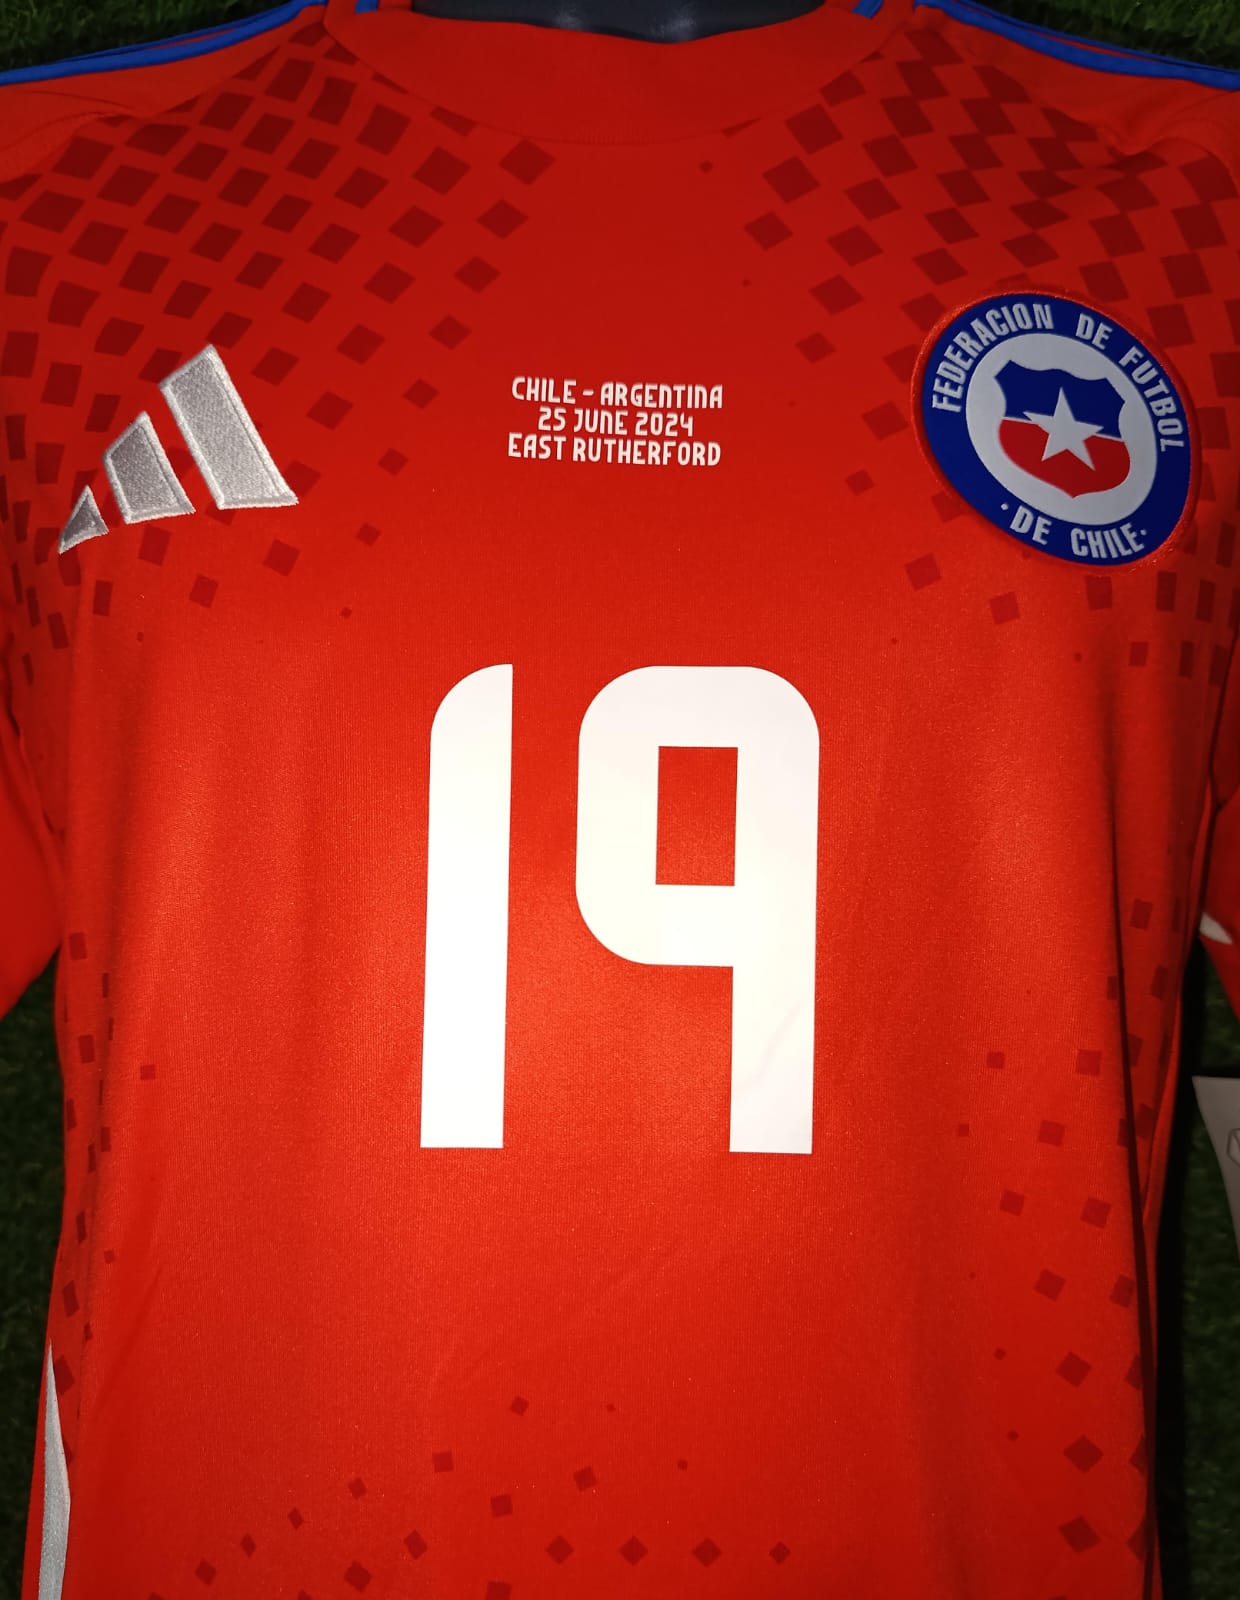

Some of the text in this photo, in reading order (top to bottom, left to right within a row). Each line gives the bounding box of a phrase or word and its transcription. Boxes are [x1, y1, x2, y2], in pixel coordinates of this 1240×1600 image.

[511, 376, 577, 404] CHILE
[600, 381, 723, 409] ARGENTINA
[932, 303, 1185, 452] FEDERACION DE FUTBOL
[538, 405, 694, 437] 25 JUNE 2024
[508, 432, 721, 466] EAST RUTHERFORD
[1009, 504, 1145, 559] DE CHILE
[420, 664, 820, 1155] 19
